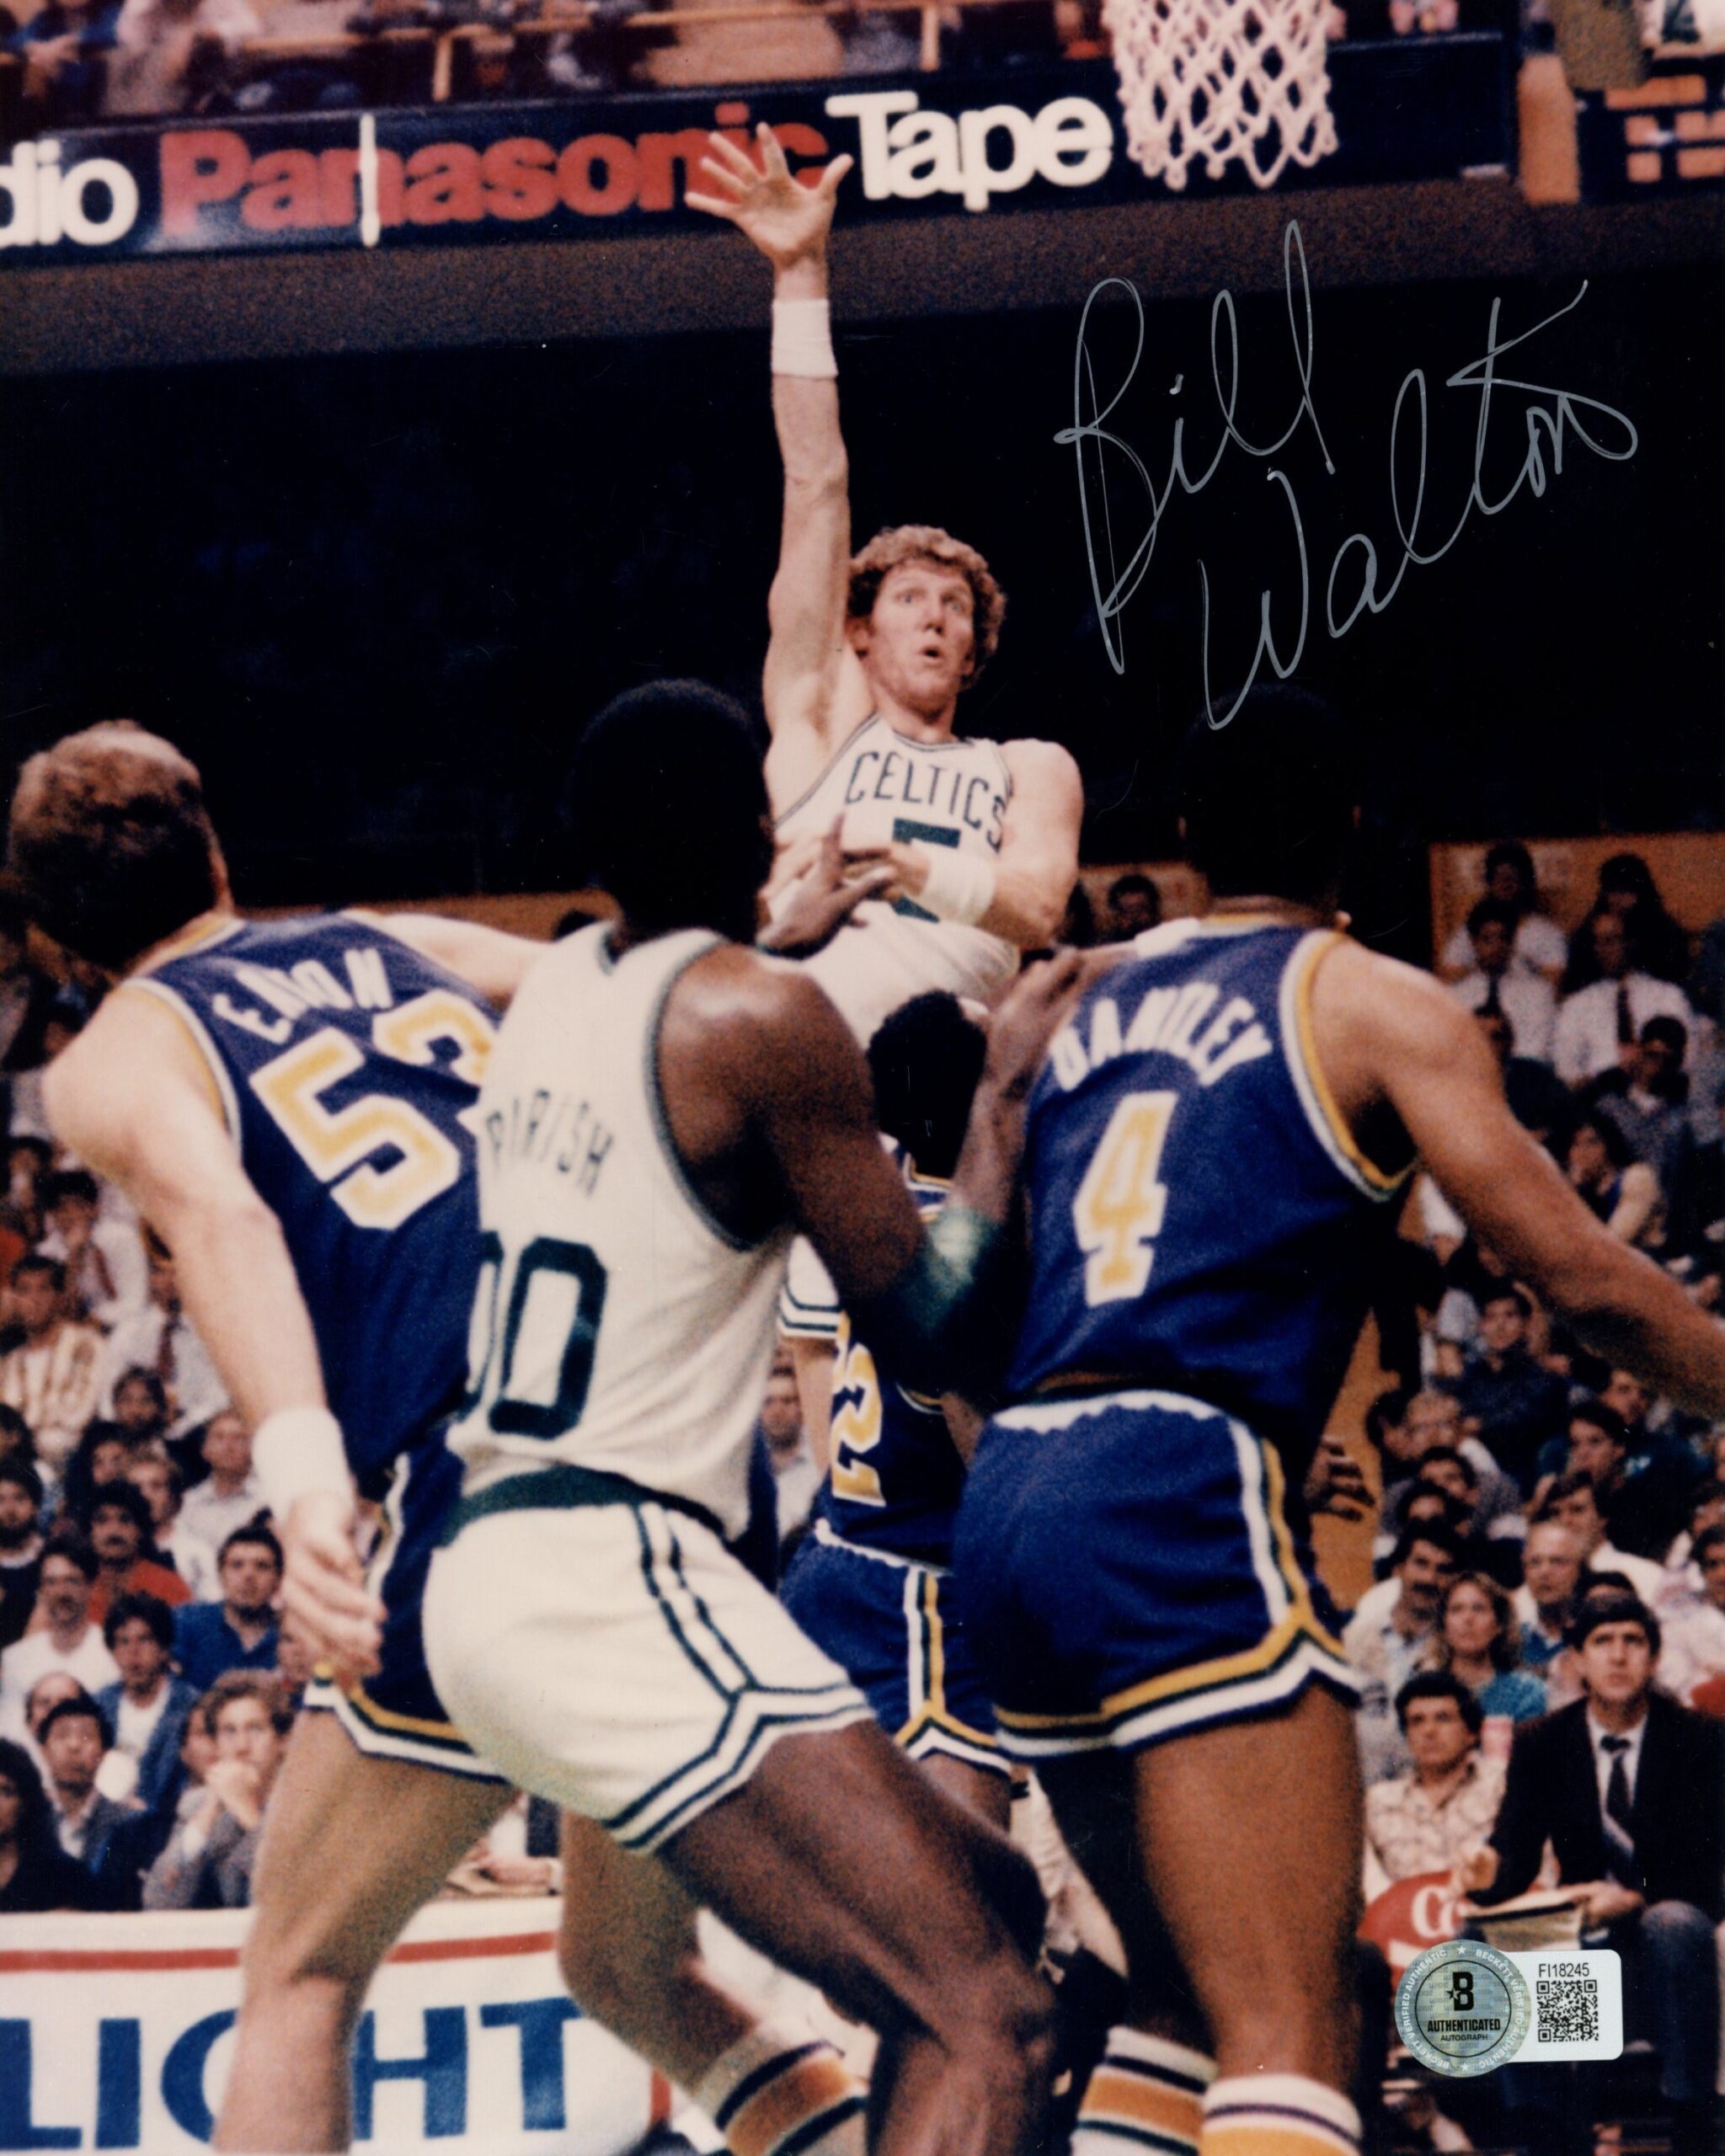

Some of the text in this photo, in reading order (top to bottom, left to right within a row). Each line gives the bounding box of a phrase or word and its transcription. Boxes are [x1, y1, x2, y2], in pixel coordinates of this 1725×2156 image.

[825, 89, 1114, 212] Tape
[1053, 220, 1335, 675] Bill
[1198, 280, 1638, 731] Walton
[844, 750, 1008, 855] CELTICS
[1072, 1090, 1178, 1308] 4
